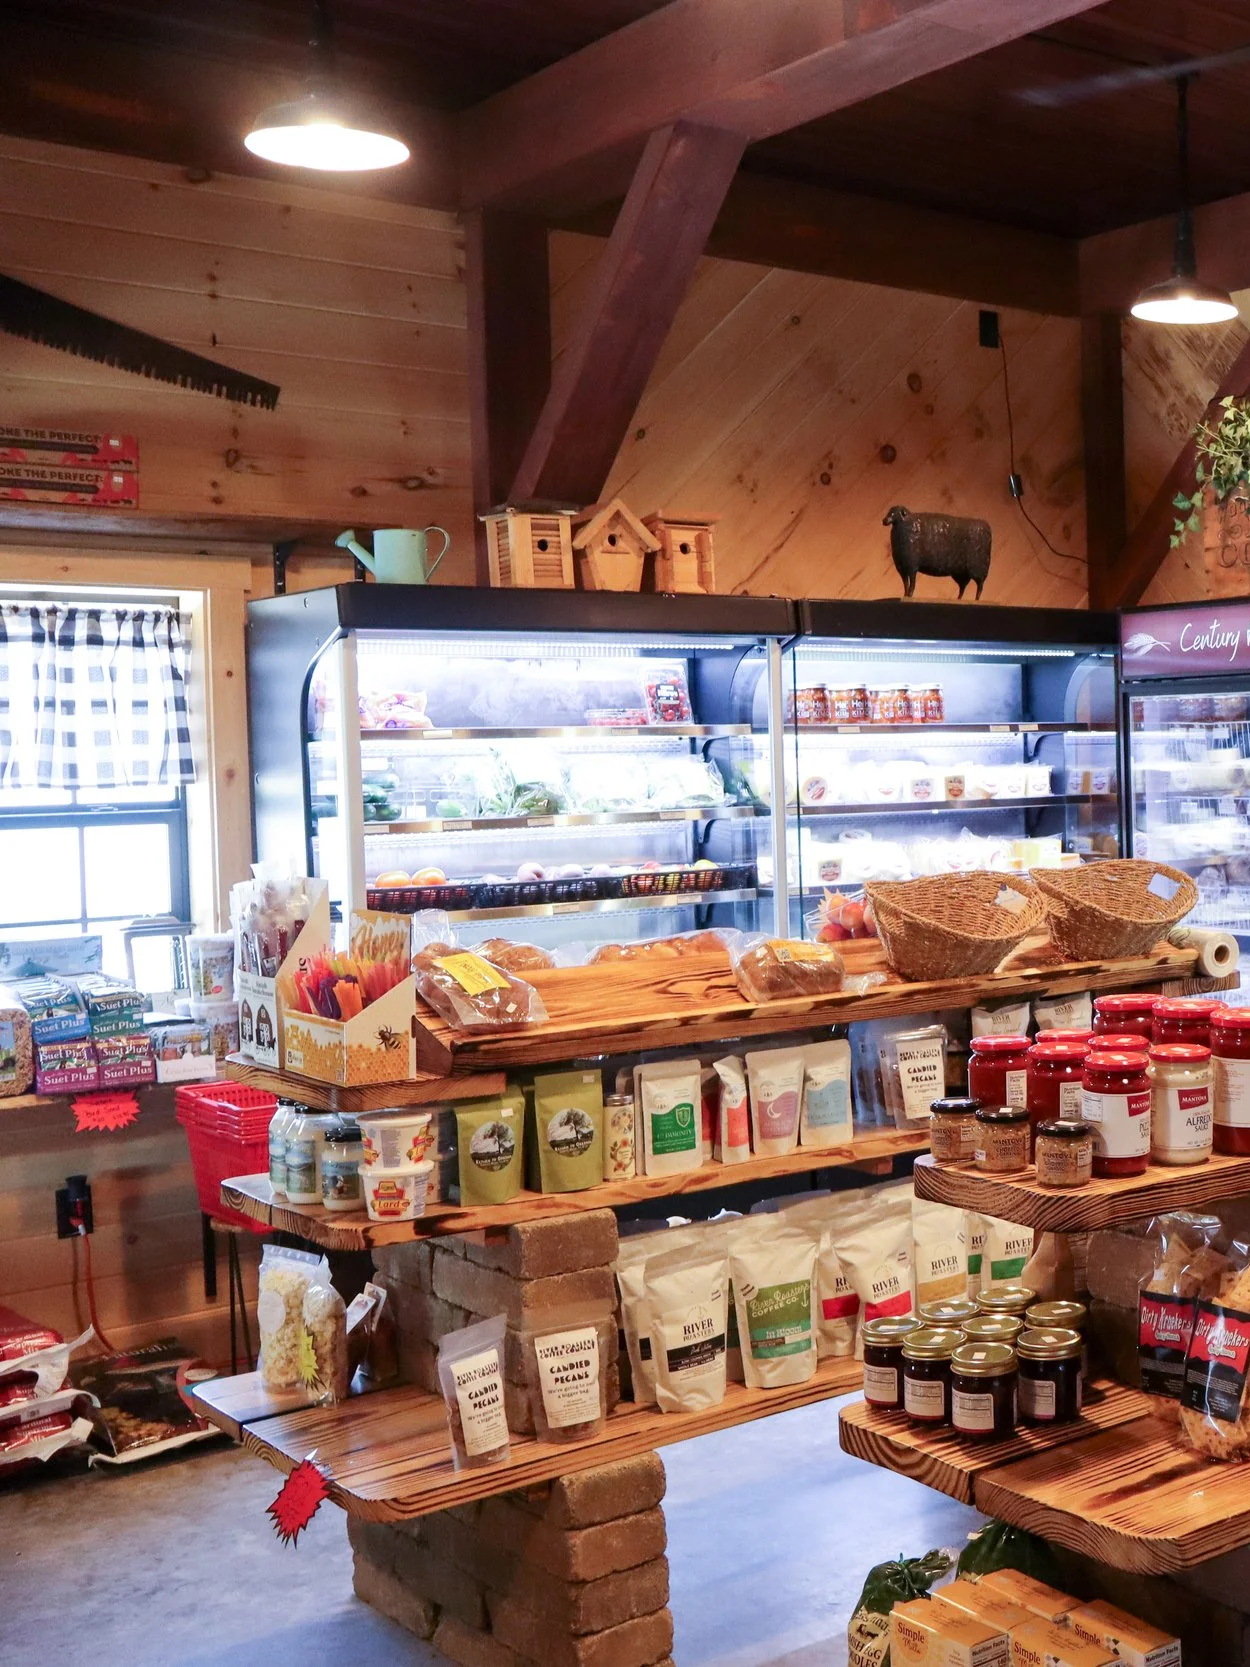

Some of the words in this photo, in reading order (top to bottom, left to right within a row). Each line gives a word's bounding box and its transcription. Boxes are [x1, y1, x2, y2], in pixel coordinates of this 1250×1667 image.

[24, 428, 45, 440] THE
[24, 469, 47, 481] THE
[1180, 619, 1241, 662] Century
[101, 1000, 121, 1010] Suet
[35, 1021, 60, 1035] Suet
[61, 1018, 85, 1029] Plus
[93, 1024, 116, 1034] Suet
[118, 1021, 141, 1030] Plus
[104, 1069, 127, 1080] Suet
[130, 1066, 153, 1076] Plus
[907, 1063, 938, 1075] CANDIED
[44, 1074, 68, 1086] Suet
[71, 1072, 96, 1082] Plus
[911, 1073, 937, 1084] PECANS
[378, 1199, 401, 1209] Lard
[931, 1255, 959, 1271] RIVER
[872, 1276, 900, 1294] RIVER
[751, 1303, 786, 1319] COFFEE
[1141, 1306, 1159, 1331] Dirty
[682, 1317, 714, 1337] RIVER
[539, 1344, 559, 1355] RIVER
[549, 1359, 592, 1375] CANDIED
[554, 1371, 590, 1385] PECANS
[468, 1382, 499, 1400] CANDIED
[473, 1395, 500, 1411] PECANS
[897, 1622, 926, 1645] Simple
[972, 1644, 993, 1657] Nutrition
[991, 1639, 1006, 1649] Facts
[1013, 1640, 1042, 1665] Simple
